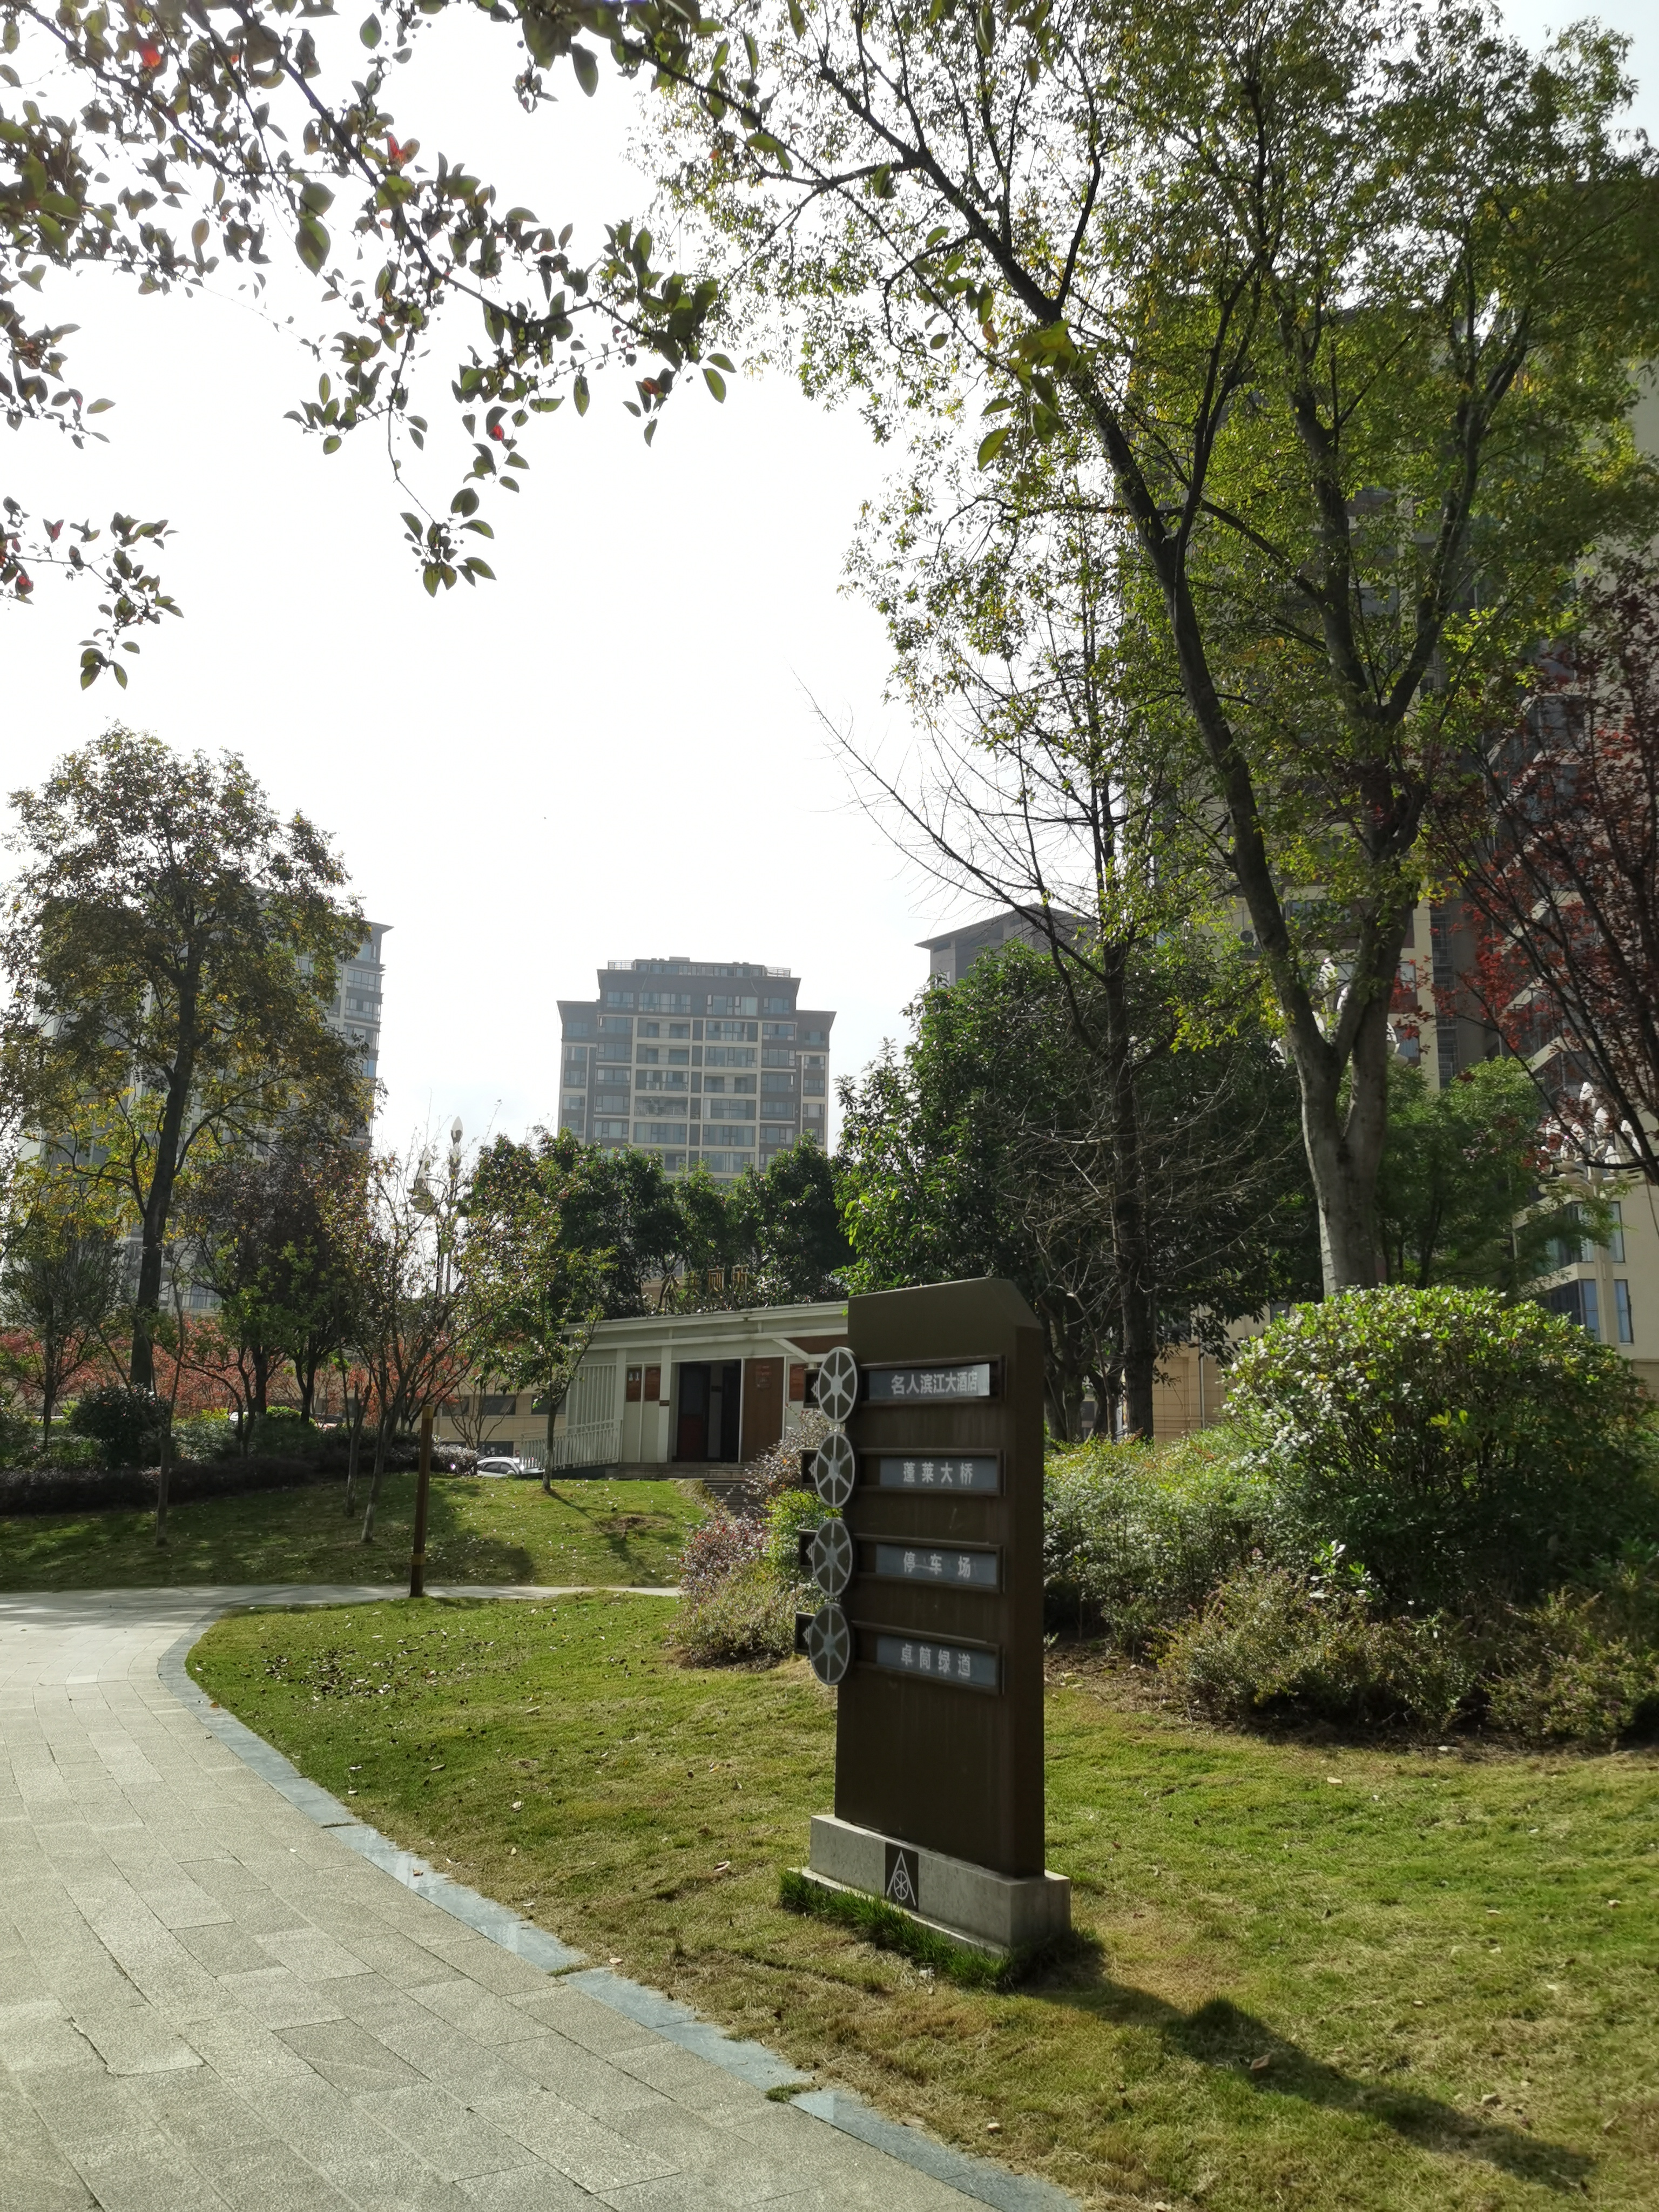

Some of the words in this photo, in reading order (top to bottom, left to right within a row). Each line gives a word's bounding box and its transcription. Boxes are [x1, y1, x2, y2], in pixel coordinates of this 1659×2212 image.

[892, 1371, 977, 1394] 名人滨江大酒店
[903, 1462, 973, 1485] 蓬莱大桥
[903, 1552, 971, 1578] 停车场
[901, 1643, 970, 1677] 卓筒绿道
